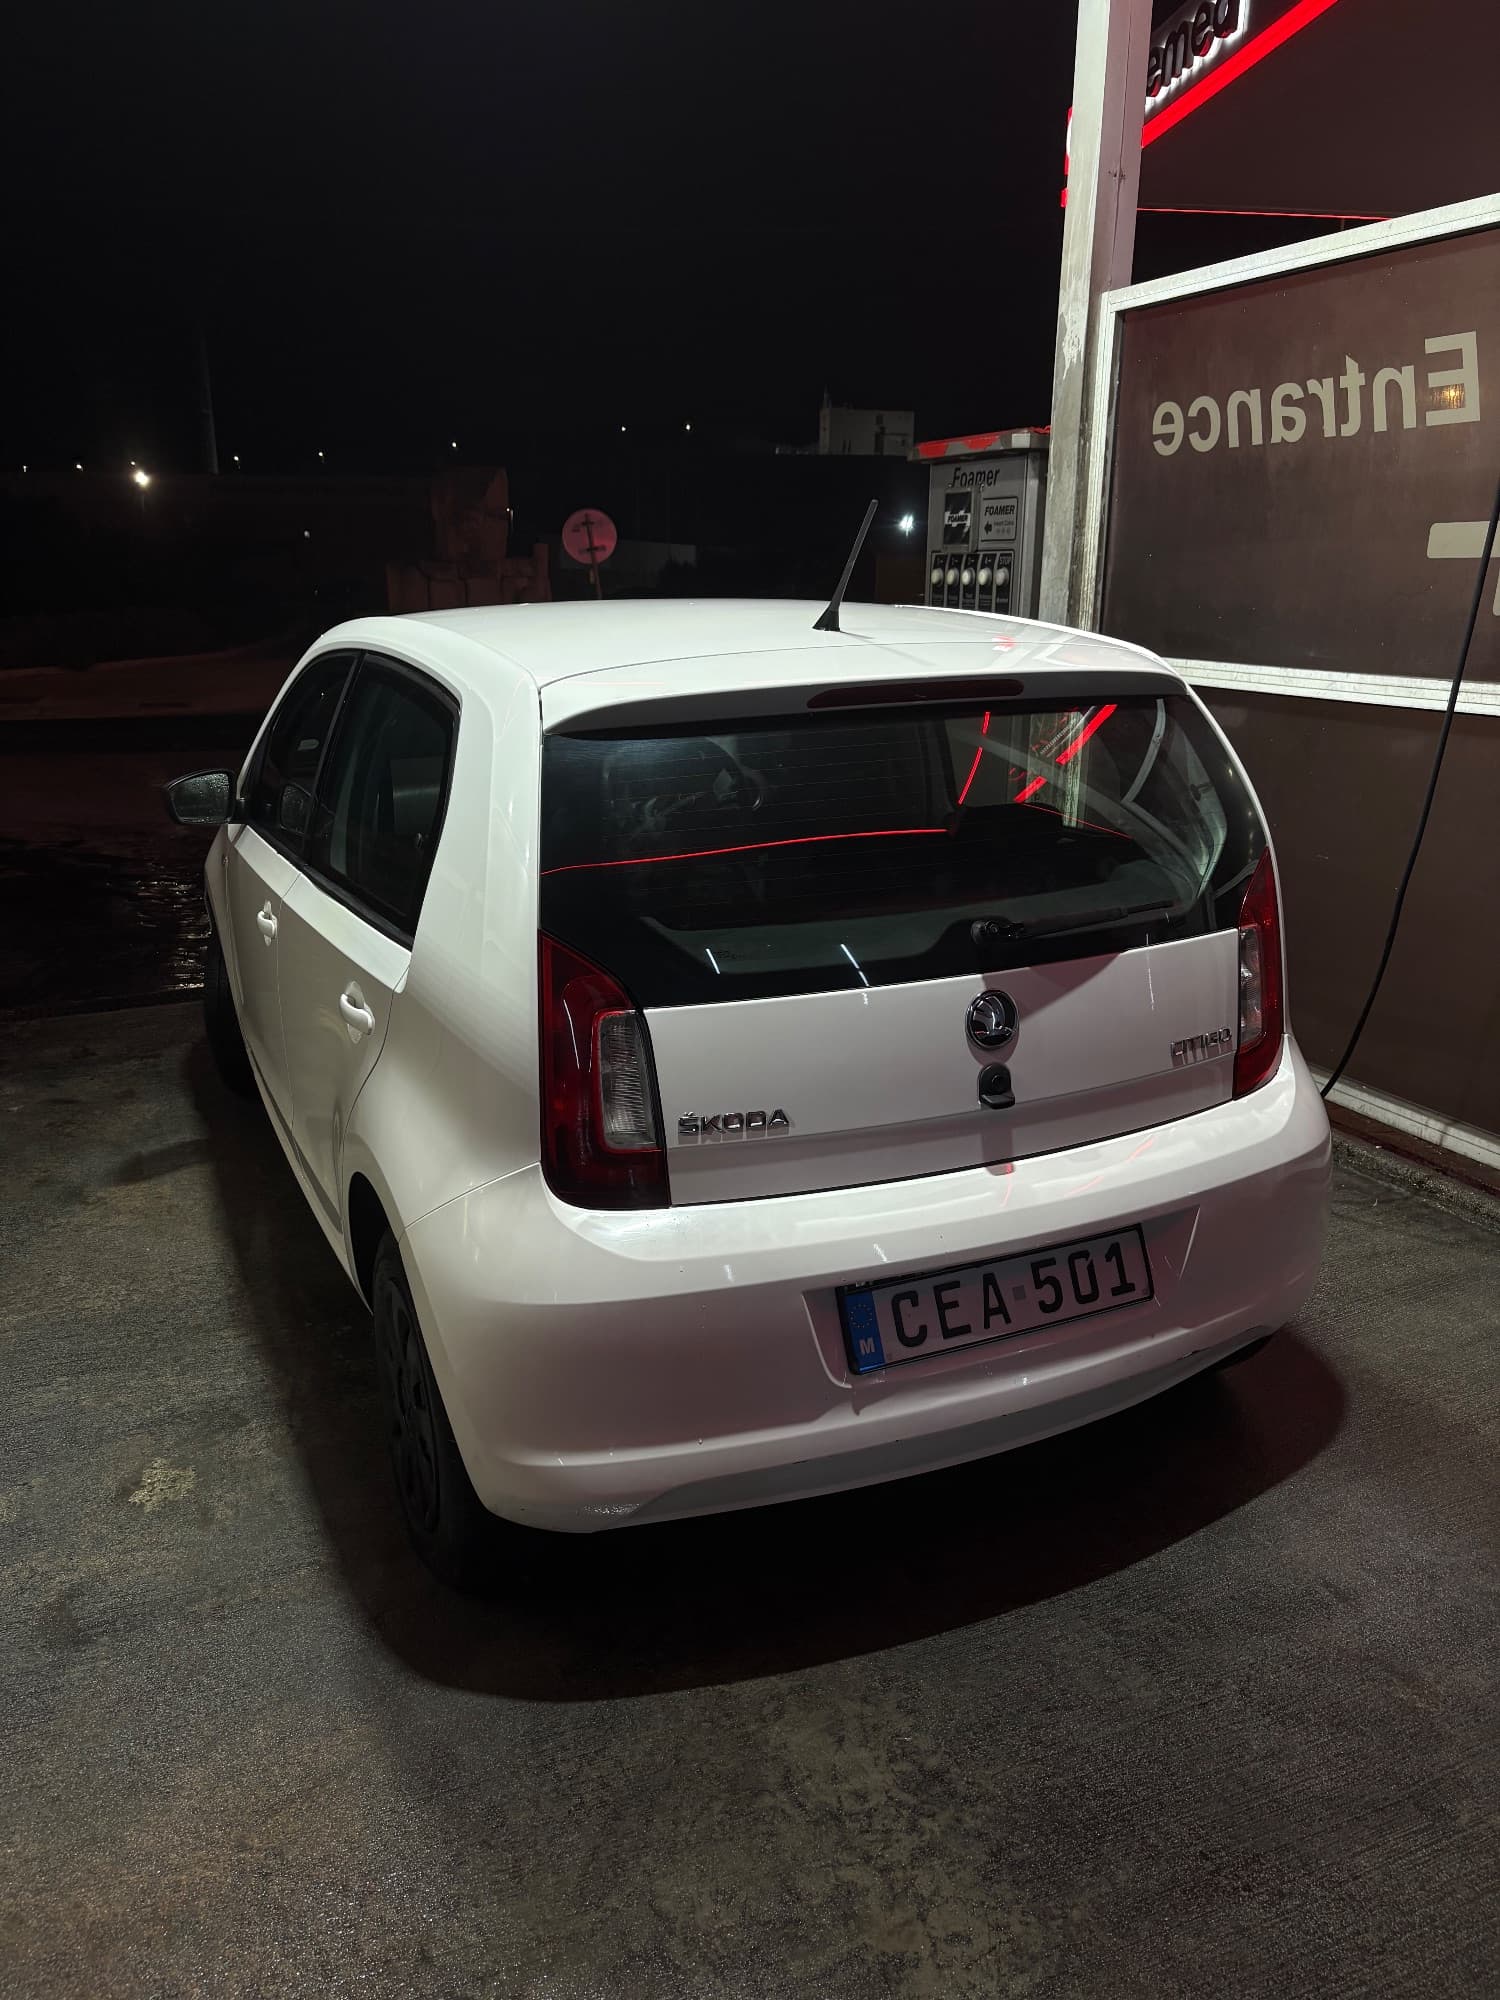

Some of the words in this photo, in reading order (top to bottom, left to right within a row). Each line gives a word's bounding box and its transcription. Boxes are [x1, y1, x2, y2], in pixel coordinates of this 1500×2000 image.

[951, 466, 1000, 488] Foamer
[948, 514, 968, 523] FOAMER
[984, 504, 1015, 516] FOAMER
[678, 1109, 789, 1134] ŠKODA
[891, 1272, 1012, 1348] CEA
[1030, 1242, 1136, 1314] 501
[859, 1337, 875, 1356] M
